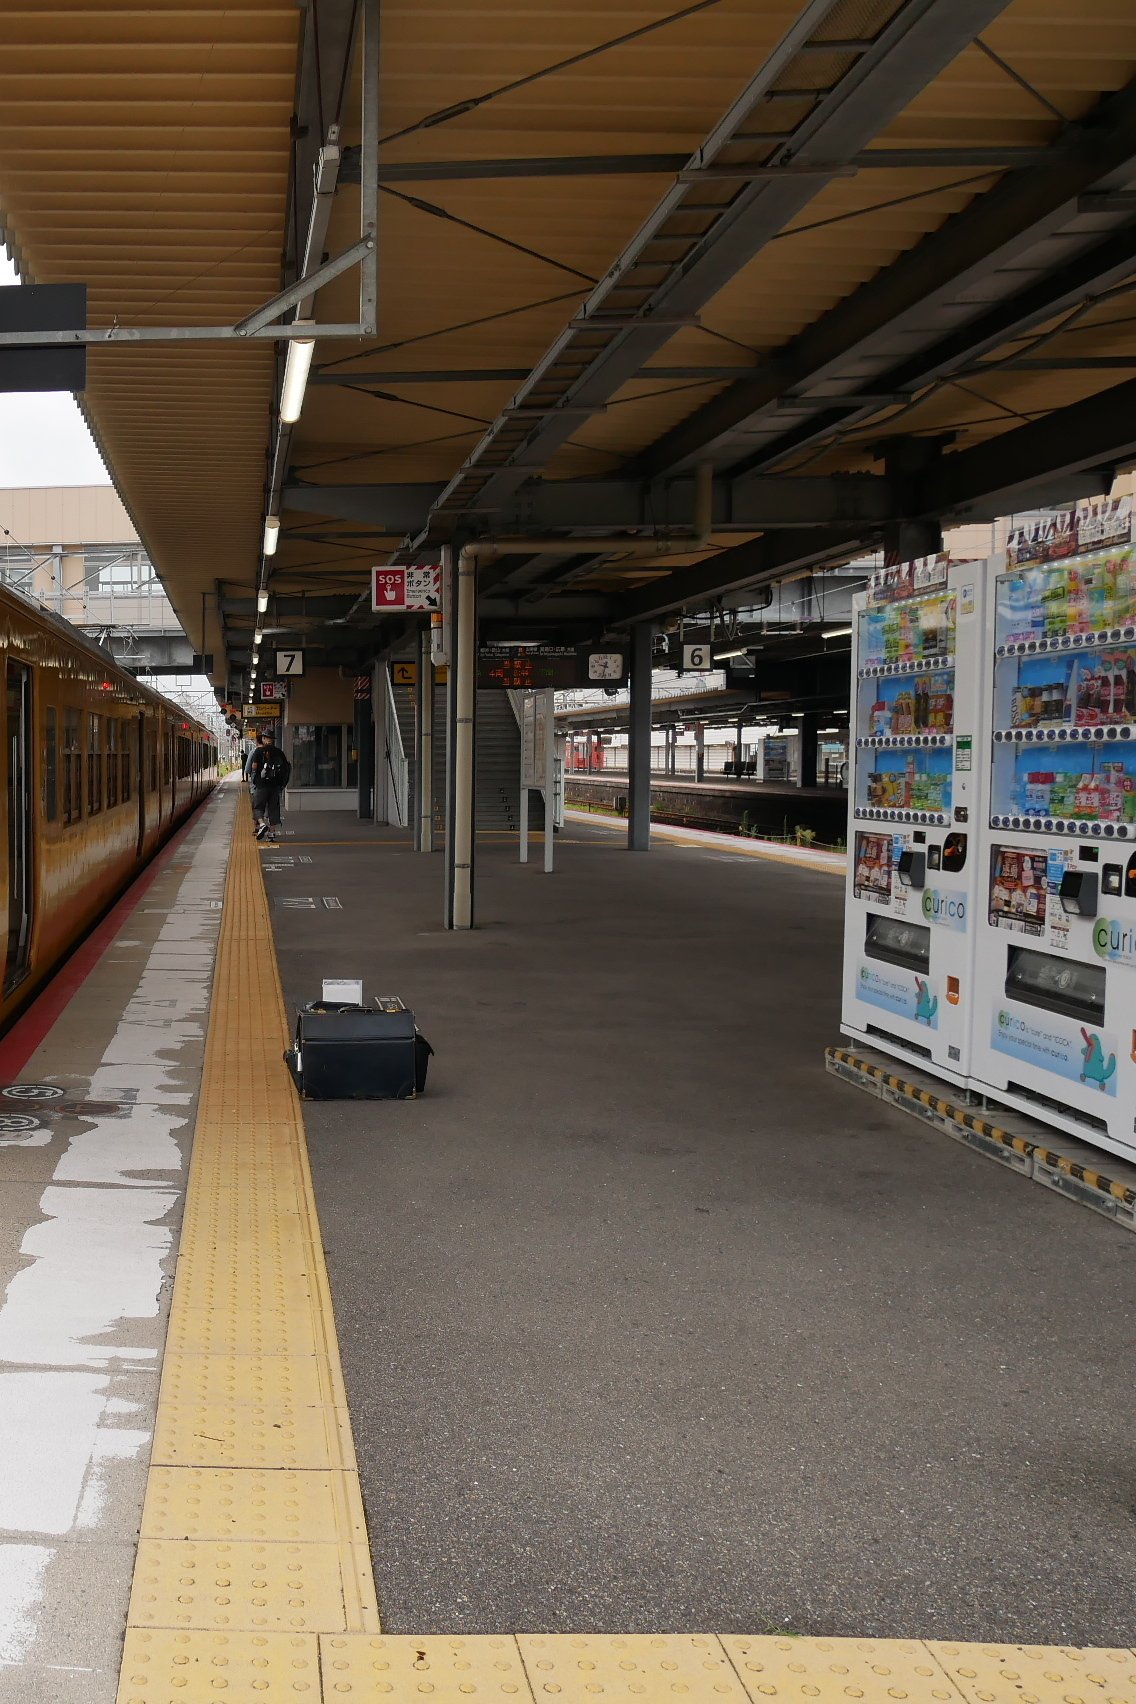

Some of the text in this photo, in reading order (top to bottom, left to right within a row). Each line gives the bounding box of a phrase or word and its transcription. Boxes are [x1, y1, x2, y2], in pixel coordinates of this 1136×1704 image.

[378, 575, 402, 584] SOS
[407, 571, 431, 579] 非常
[283, 654, 296, 673] 7
[690, 648, 703, 667] 6
[924, 896, 965, 919] curico
[1097, 928, 1136, 954] curi
[999, 1013, 1026, 1032] curico
